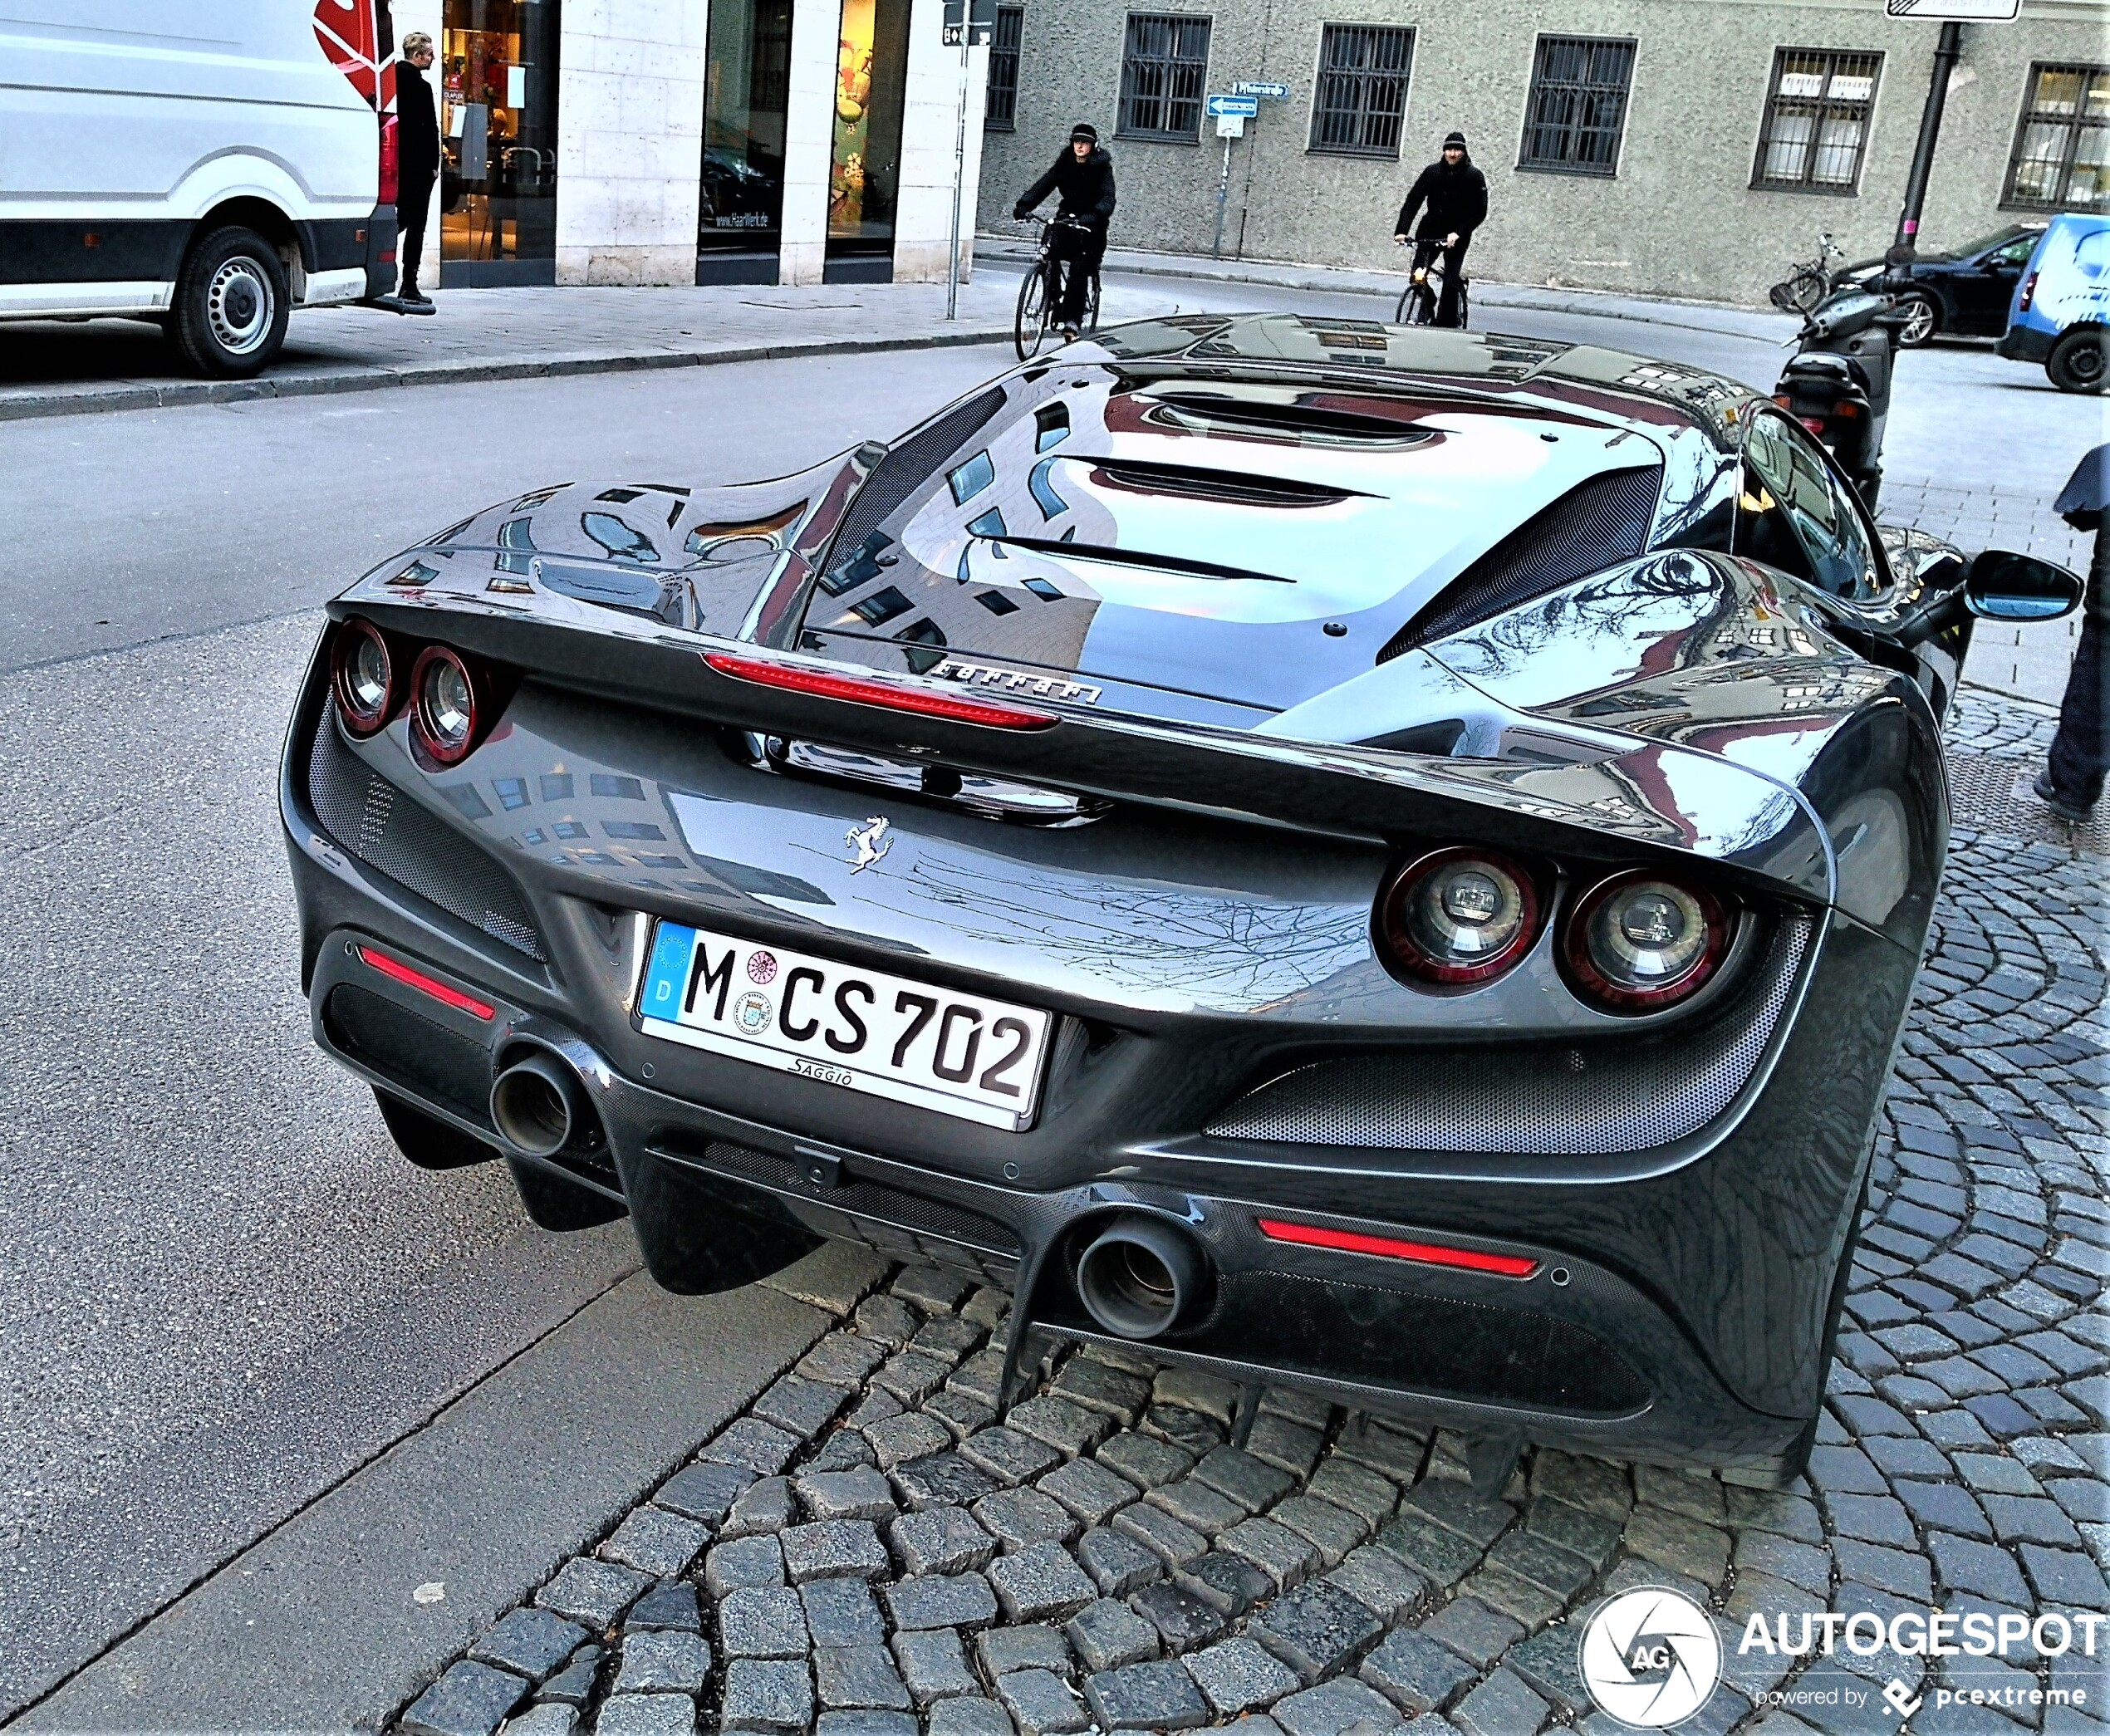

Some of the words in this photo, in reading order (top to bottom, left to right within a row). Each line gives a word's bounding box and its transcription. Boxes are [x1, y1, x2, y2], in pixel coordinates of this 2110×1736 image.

[931, 660, 1103, 704] Ferrari
[655, 979, 671, 1002] D
[685, 942, 736, 1021] M
[779, 966, 876, 1055] CS
[891, 990, 1034, 1098] 702
